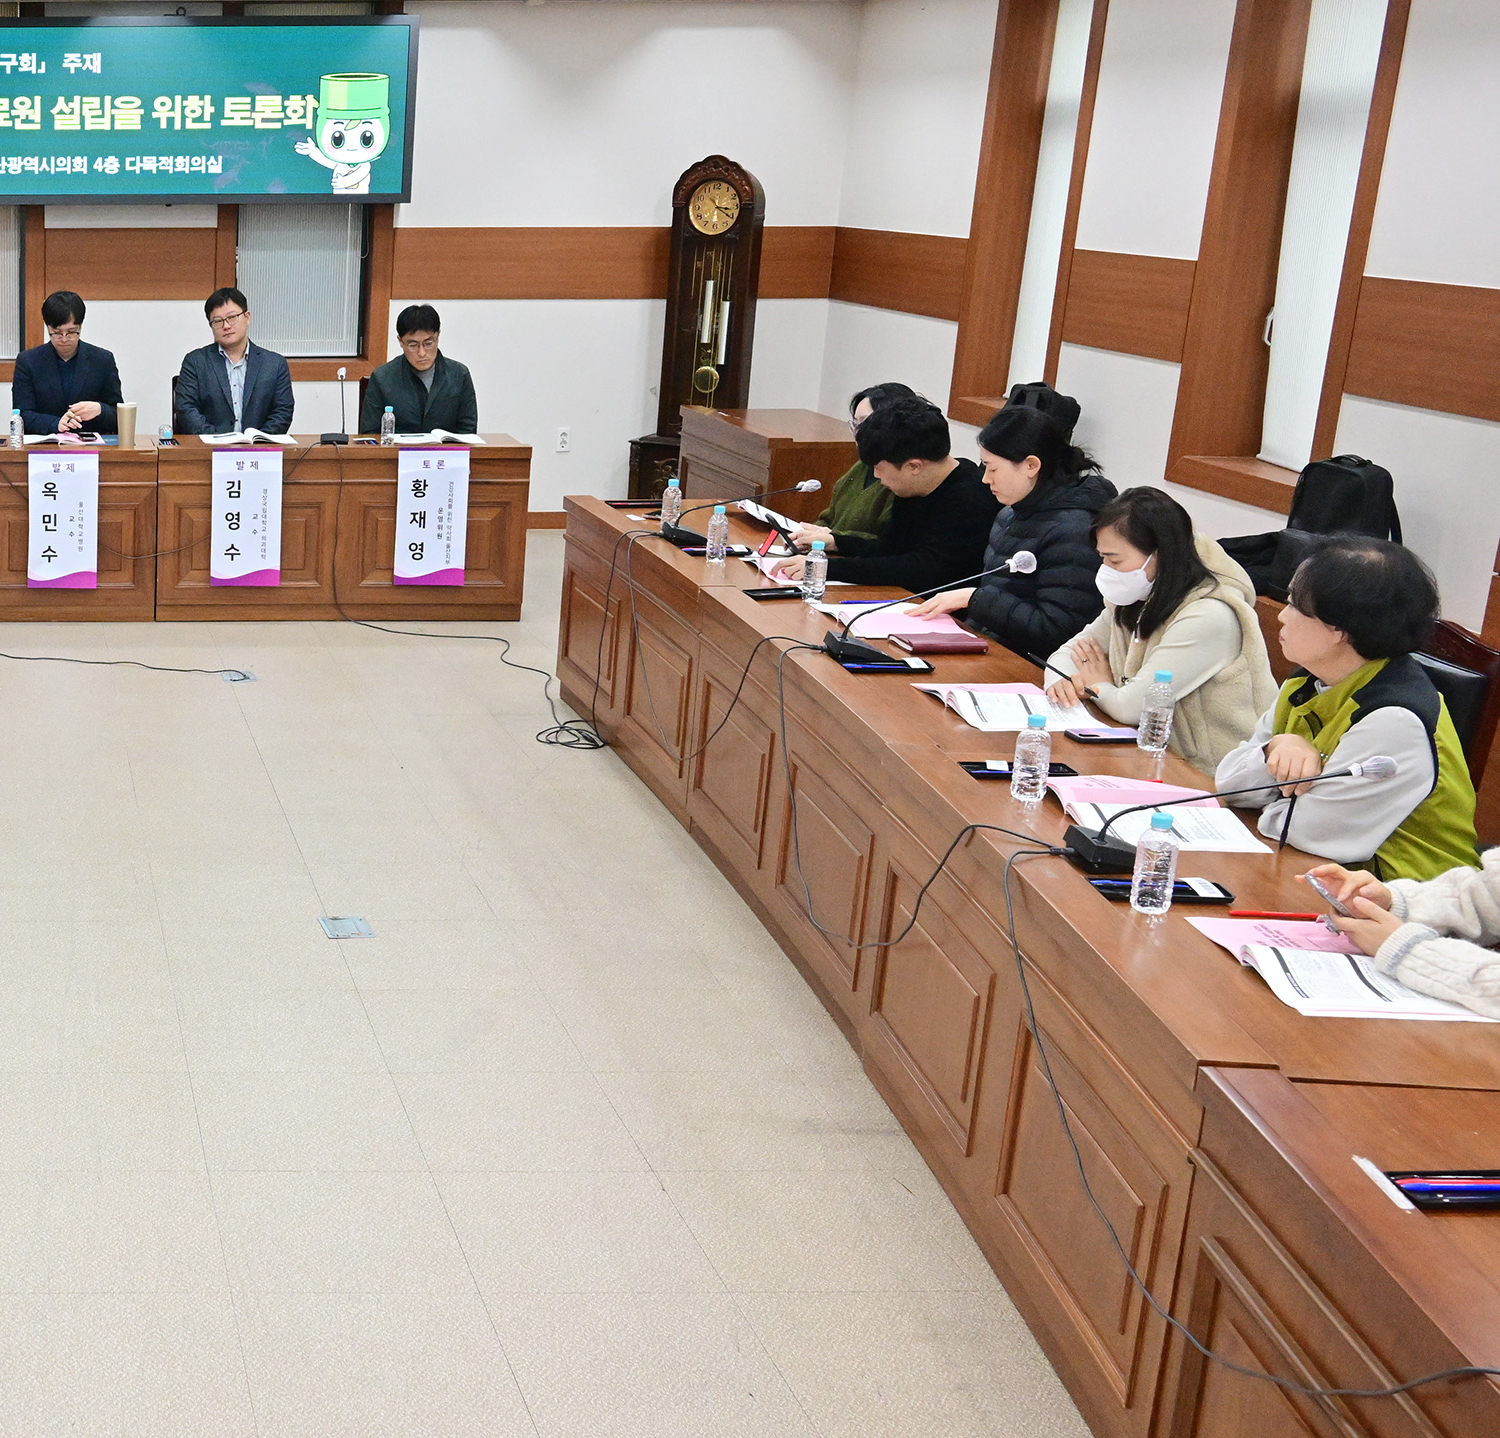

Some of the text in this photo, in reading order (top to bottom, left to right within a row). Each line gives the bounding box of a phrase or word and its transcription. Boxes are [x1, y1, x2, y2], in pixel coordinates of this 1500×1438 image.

[62, 52, 102, 74] 주재
[50, 95, 144, 131] 설립을
[151, 94, 215, 131] 위한
[220, 94, 314, 130] 토론회
[92, 156, 121, 174] 4층
[125, 156, 223, 174] 다목적회의실
[52, 463, 75, 472] 발제
[236, 460, 259, 470] 발제
[422, 460, 446, 470] 토론
[42, 482, 58, 563] 옥민수
[68, 516, 75, 538] 교수
[224, 480, 242, 561] 김영수
[252, 514, 258, 535] 교수
[408, 479, 428, 561] 황재영
